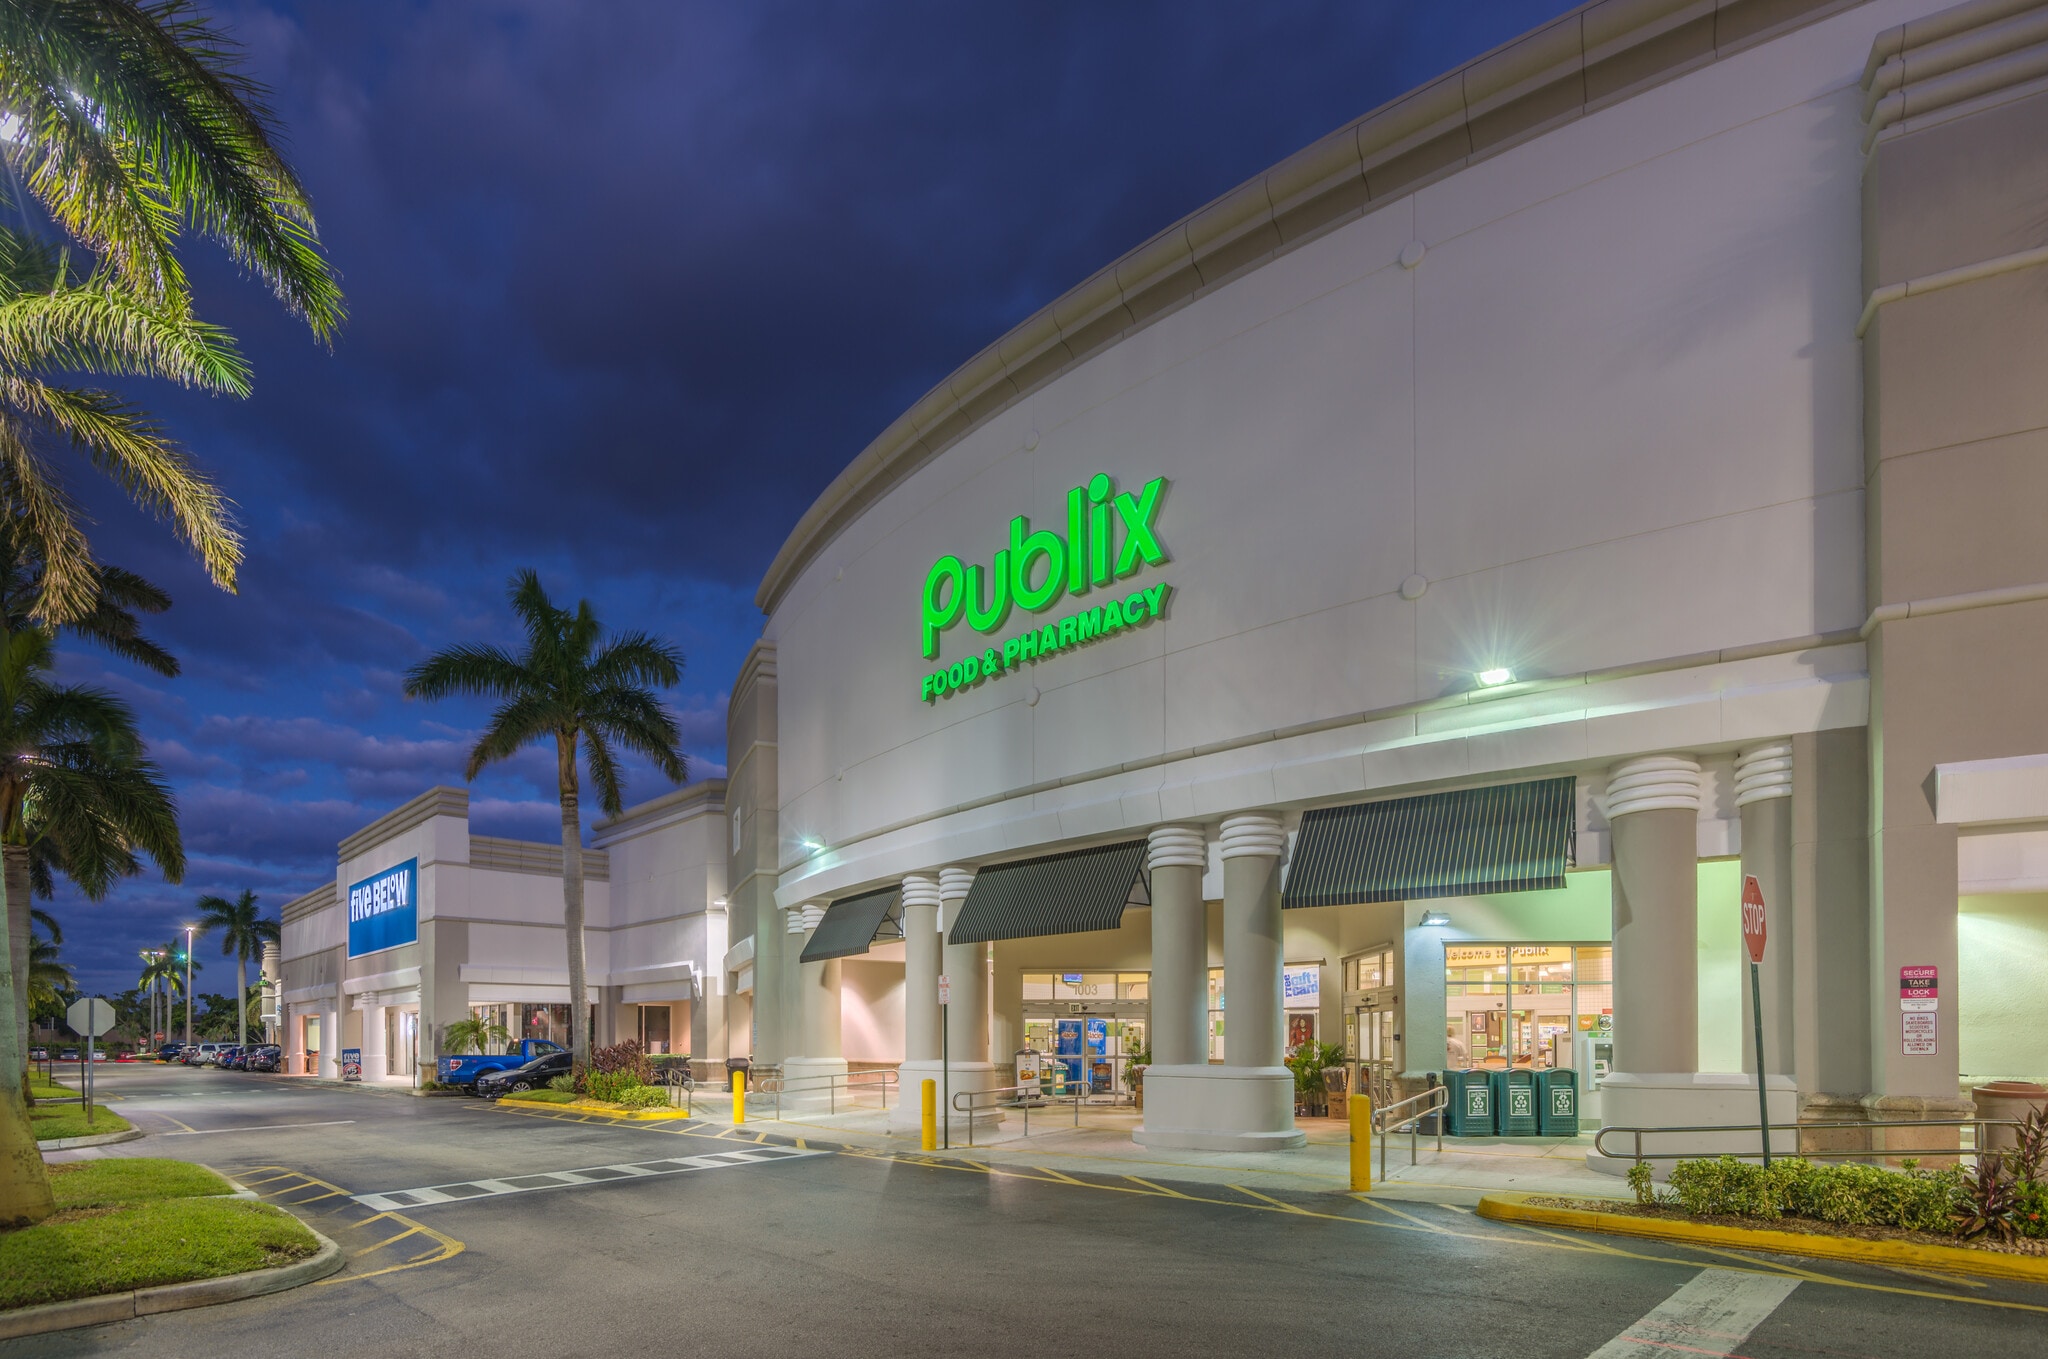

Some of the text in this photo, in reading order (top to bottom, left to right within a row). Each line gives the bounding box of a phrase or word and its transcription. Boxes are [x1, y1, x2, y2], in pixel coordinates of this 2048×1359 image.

[922, 473, 1169, 660] Publix
[922, 583, 1171, 703] FOOD & PHARMACY
[351, 869, 409, 922] five BELOW
[1743, 902, 1765, 935] STOP
[1073, 984, 1098, 996] 1003
